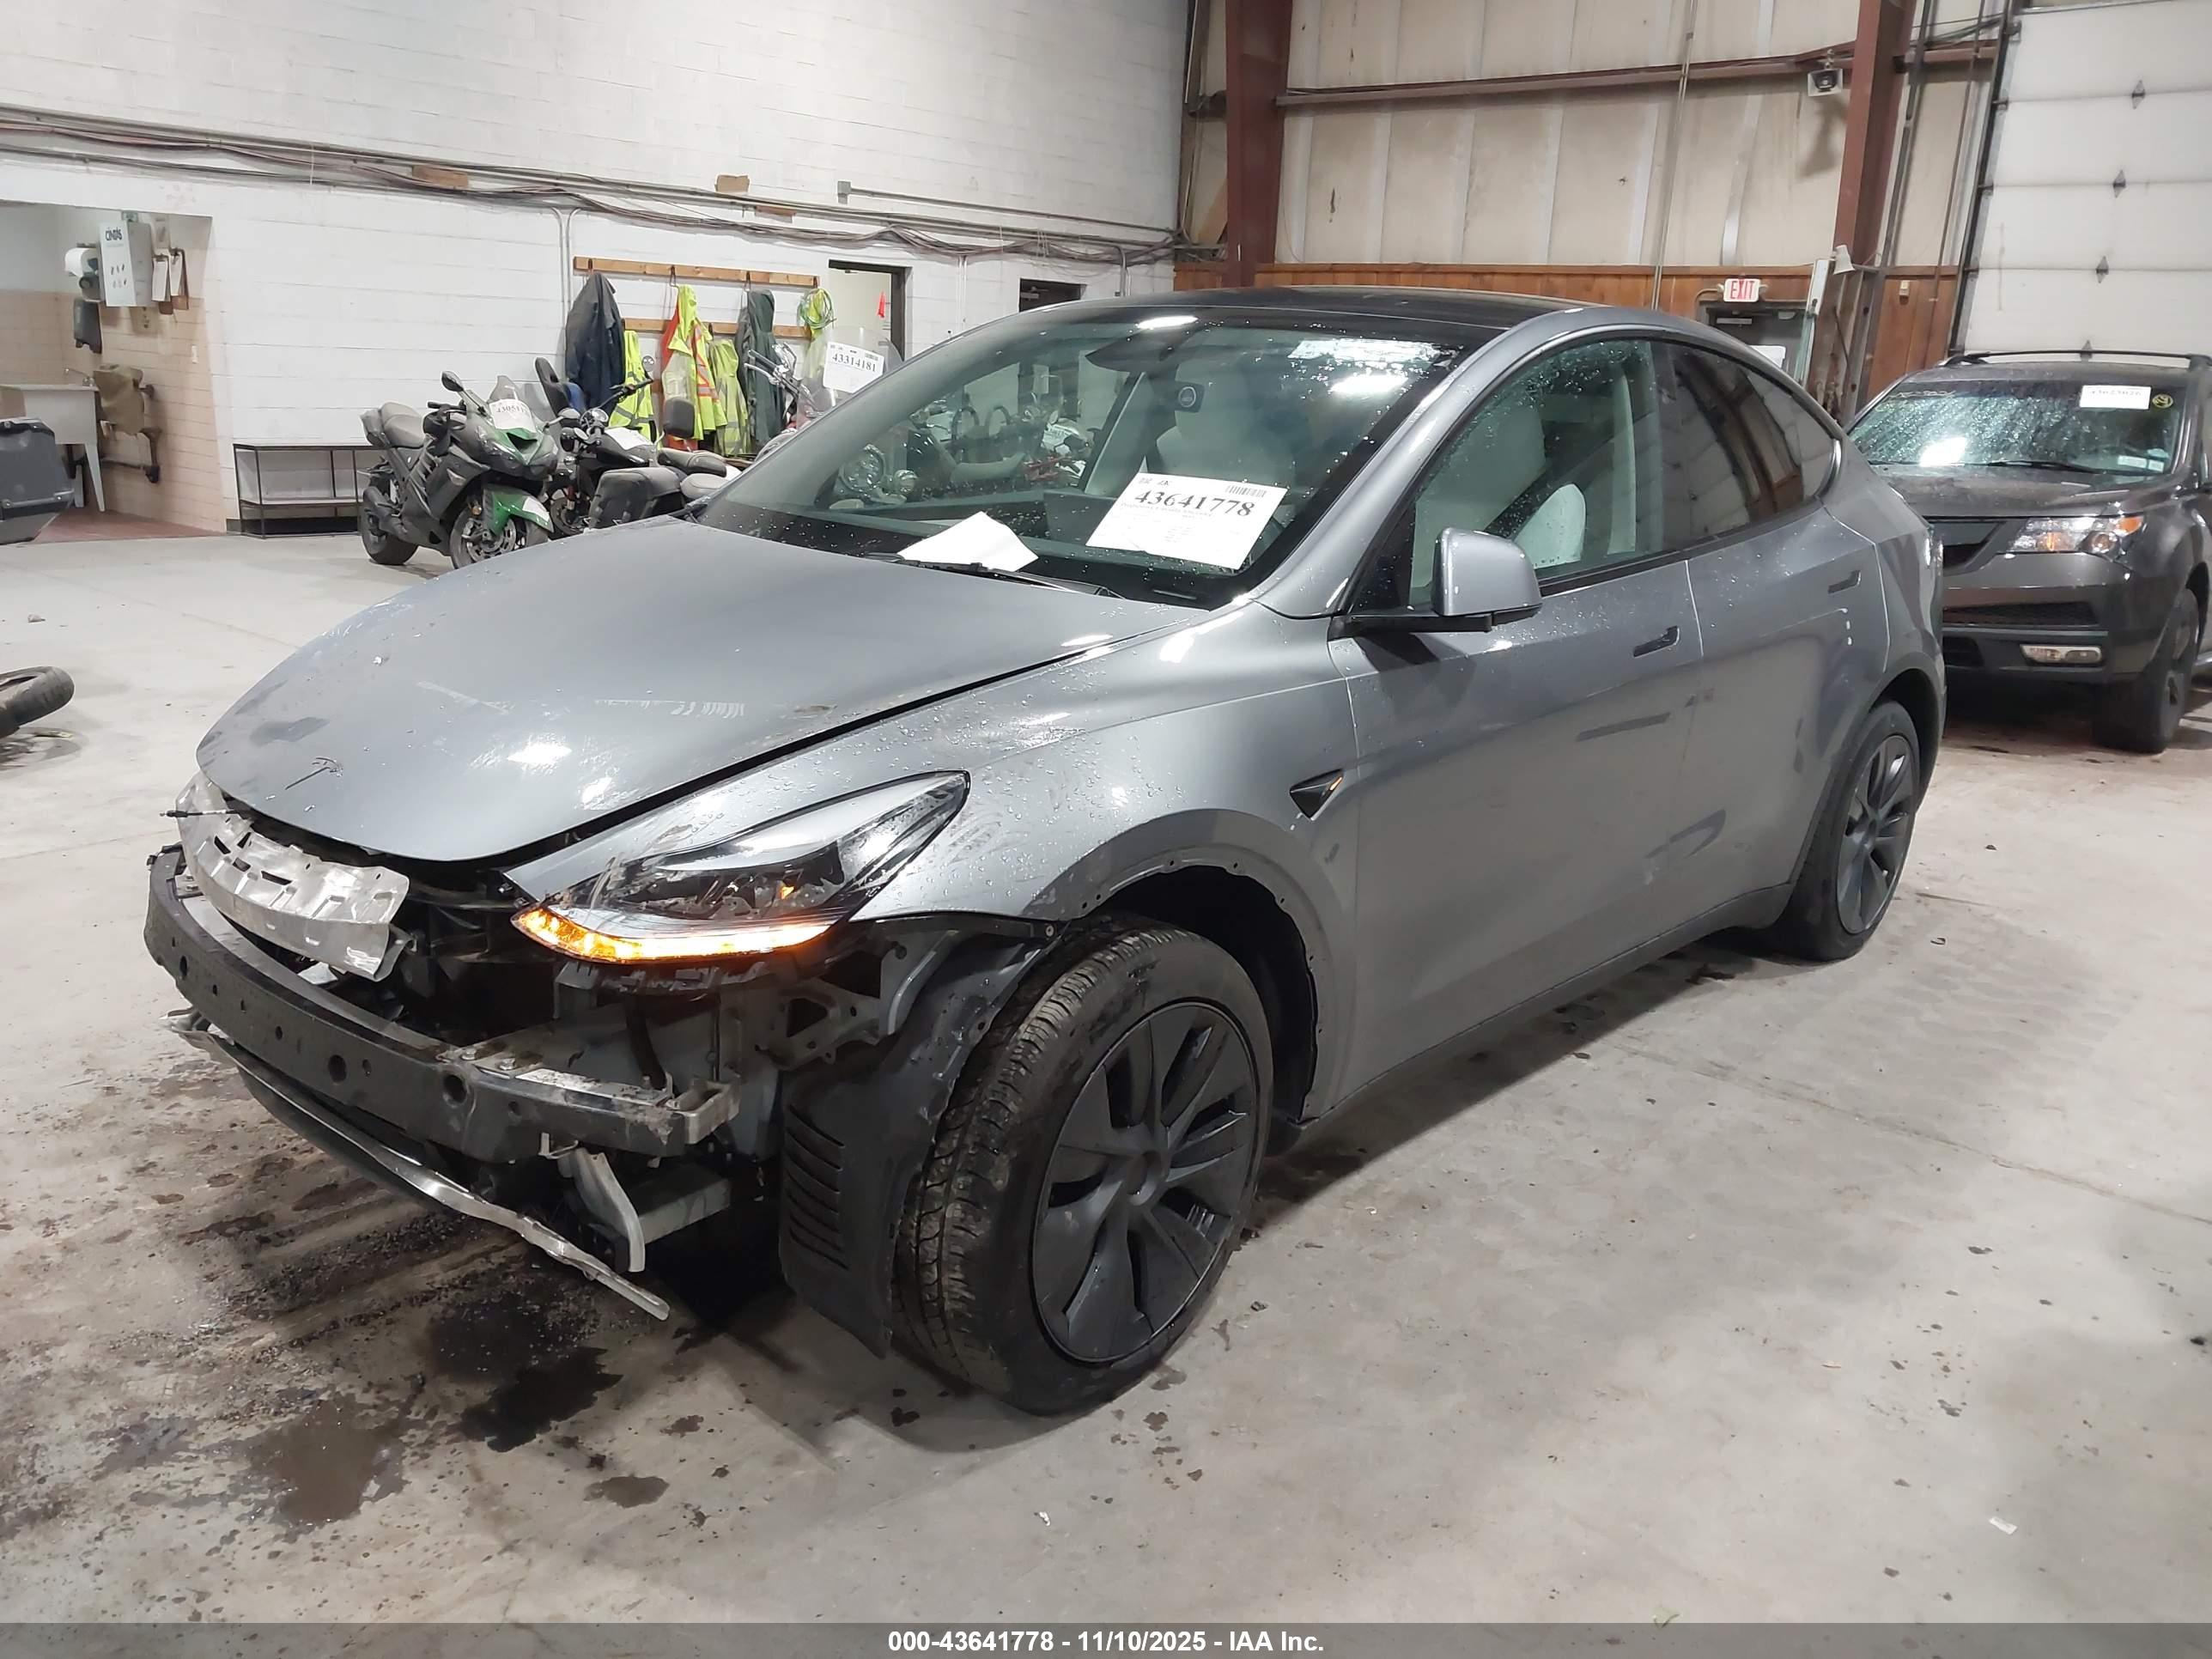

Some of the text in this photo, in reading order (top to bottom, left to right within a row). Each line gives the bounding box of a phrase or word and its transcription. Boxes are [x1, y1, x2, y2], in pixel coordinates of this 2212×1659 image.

[1730, 280, 1755, 300] EXIT
[831, 353, 877, 373] 43314181
[1134, 489, 1255, 517] 43641778
